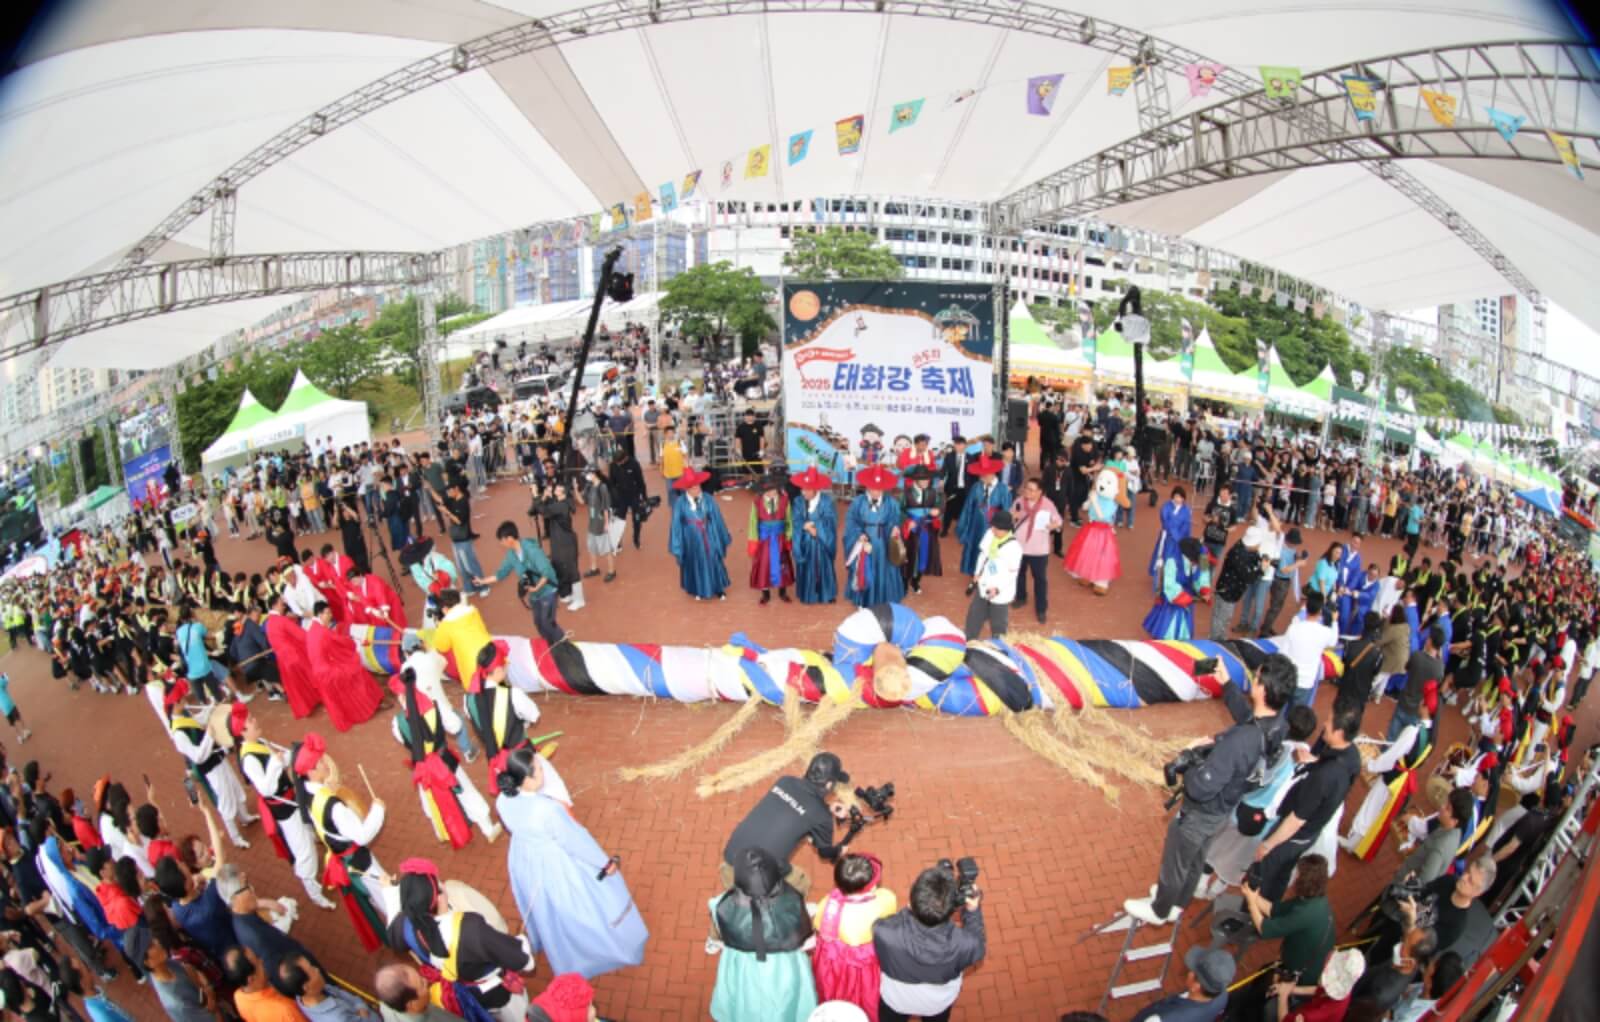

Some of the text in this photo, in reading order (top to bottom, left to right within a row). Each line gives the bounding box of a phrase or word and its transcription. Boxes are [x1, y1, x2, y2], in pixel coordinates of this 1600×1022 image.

[801, 377, 831, 390] 2025
[833, 363, 912, 391] 태화강
[921, 365, 976, 399] 축제
